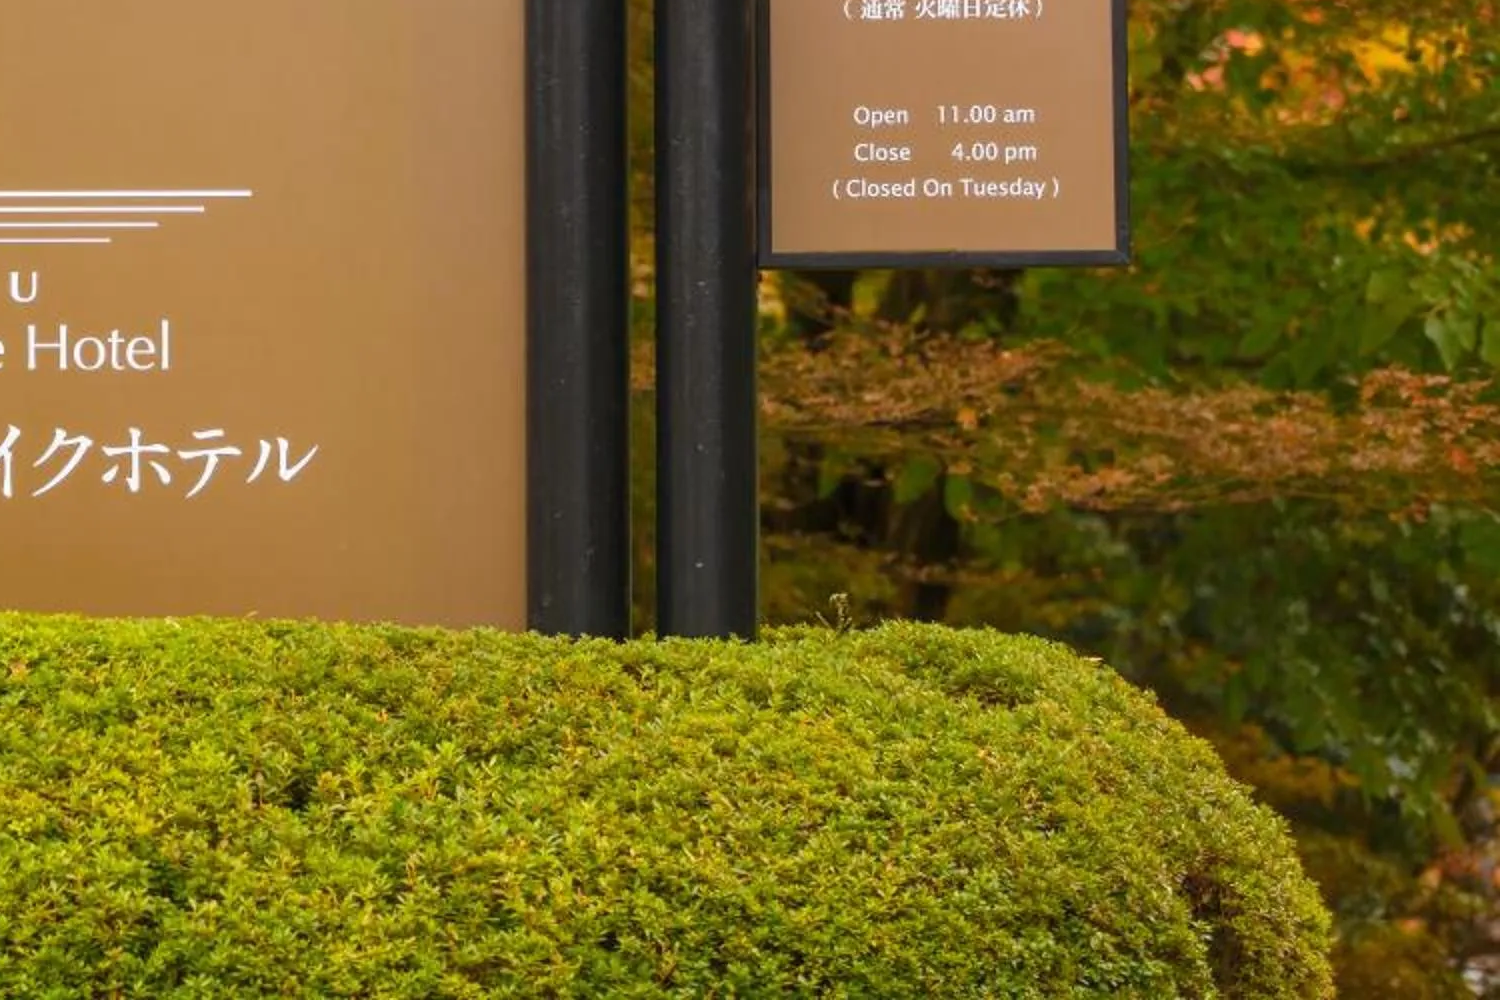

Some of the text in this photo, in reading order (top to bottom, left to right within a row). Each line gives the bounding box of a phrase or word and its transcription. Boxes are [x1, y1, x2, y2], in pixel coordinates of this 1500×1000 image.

[853, 105, 1035, 129] Open 11.00 am
[854, 142, 1037, 165] Close 4.00 pm
[923, 178, 952, 197] On
[27, 319, 169, 371] Hotel
